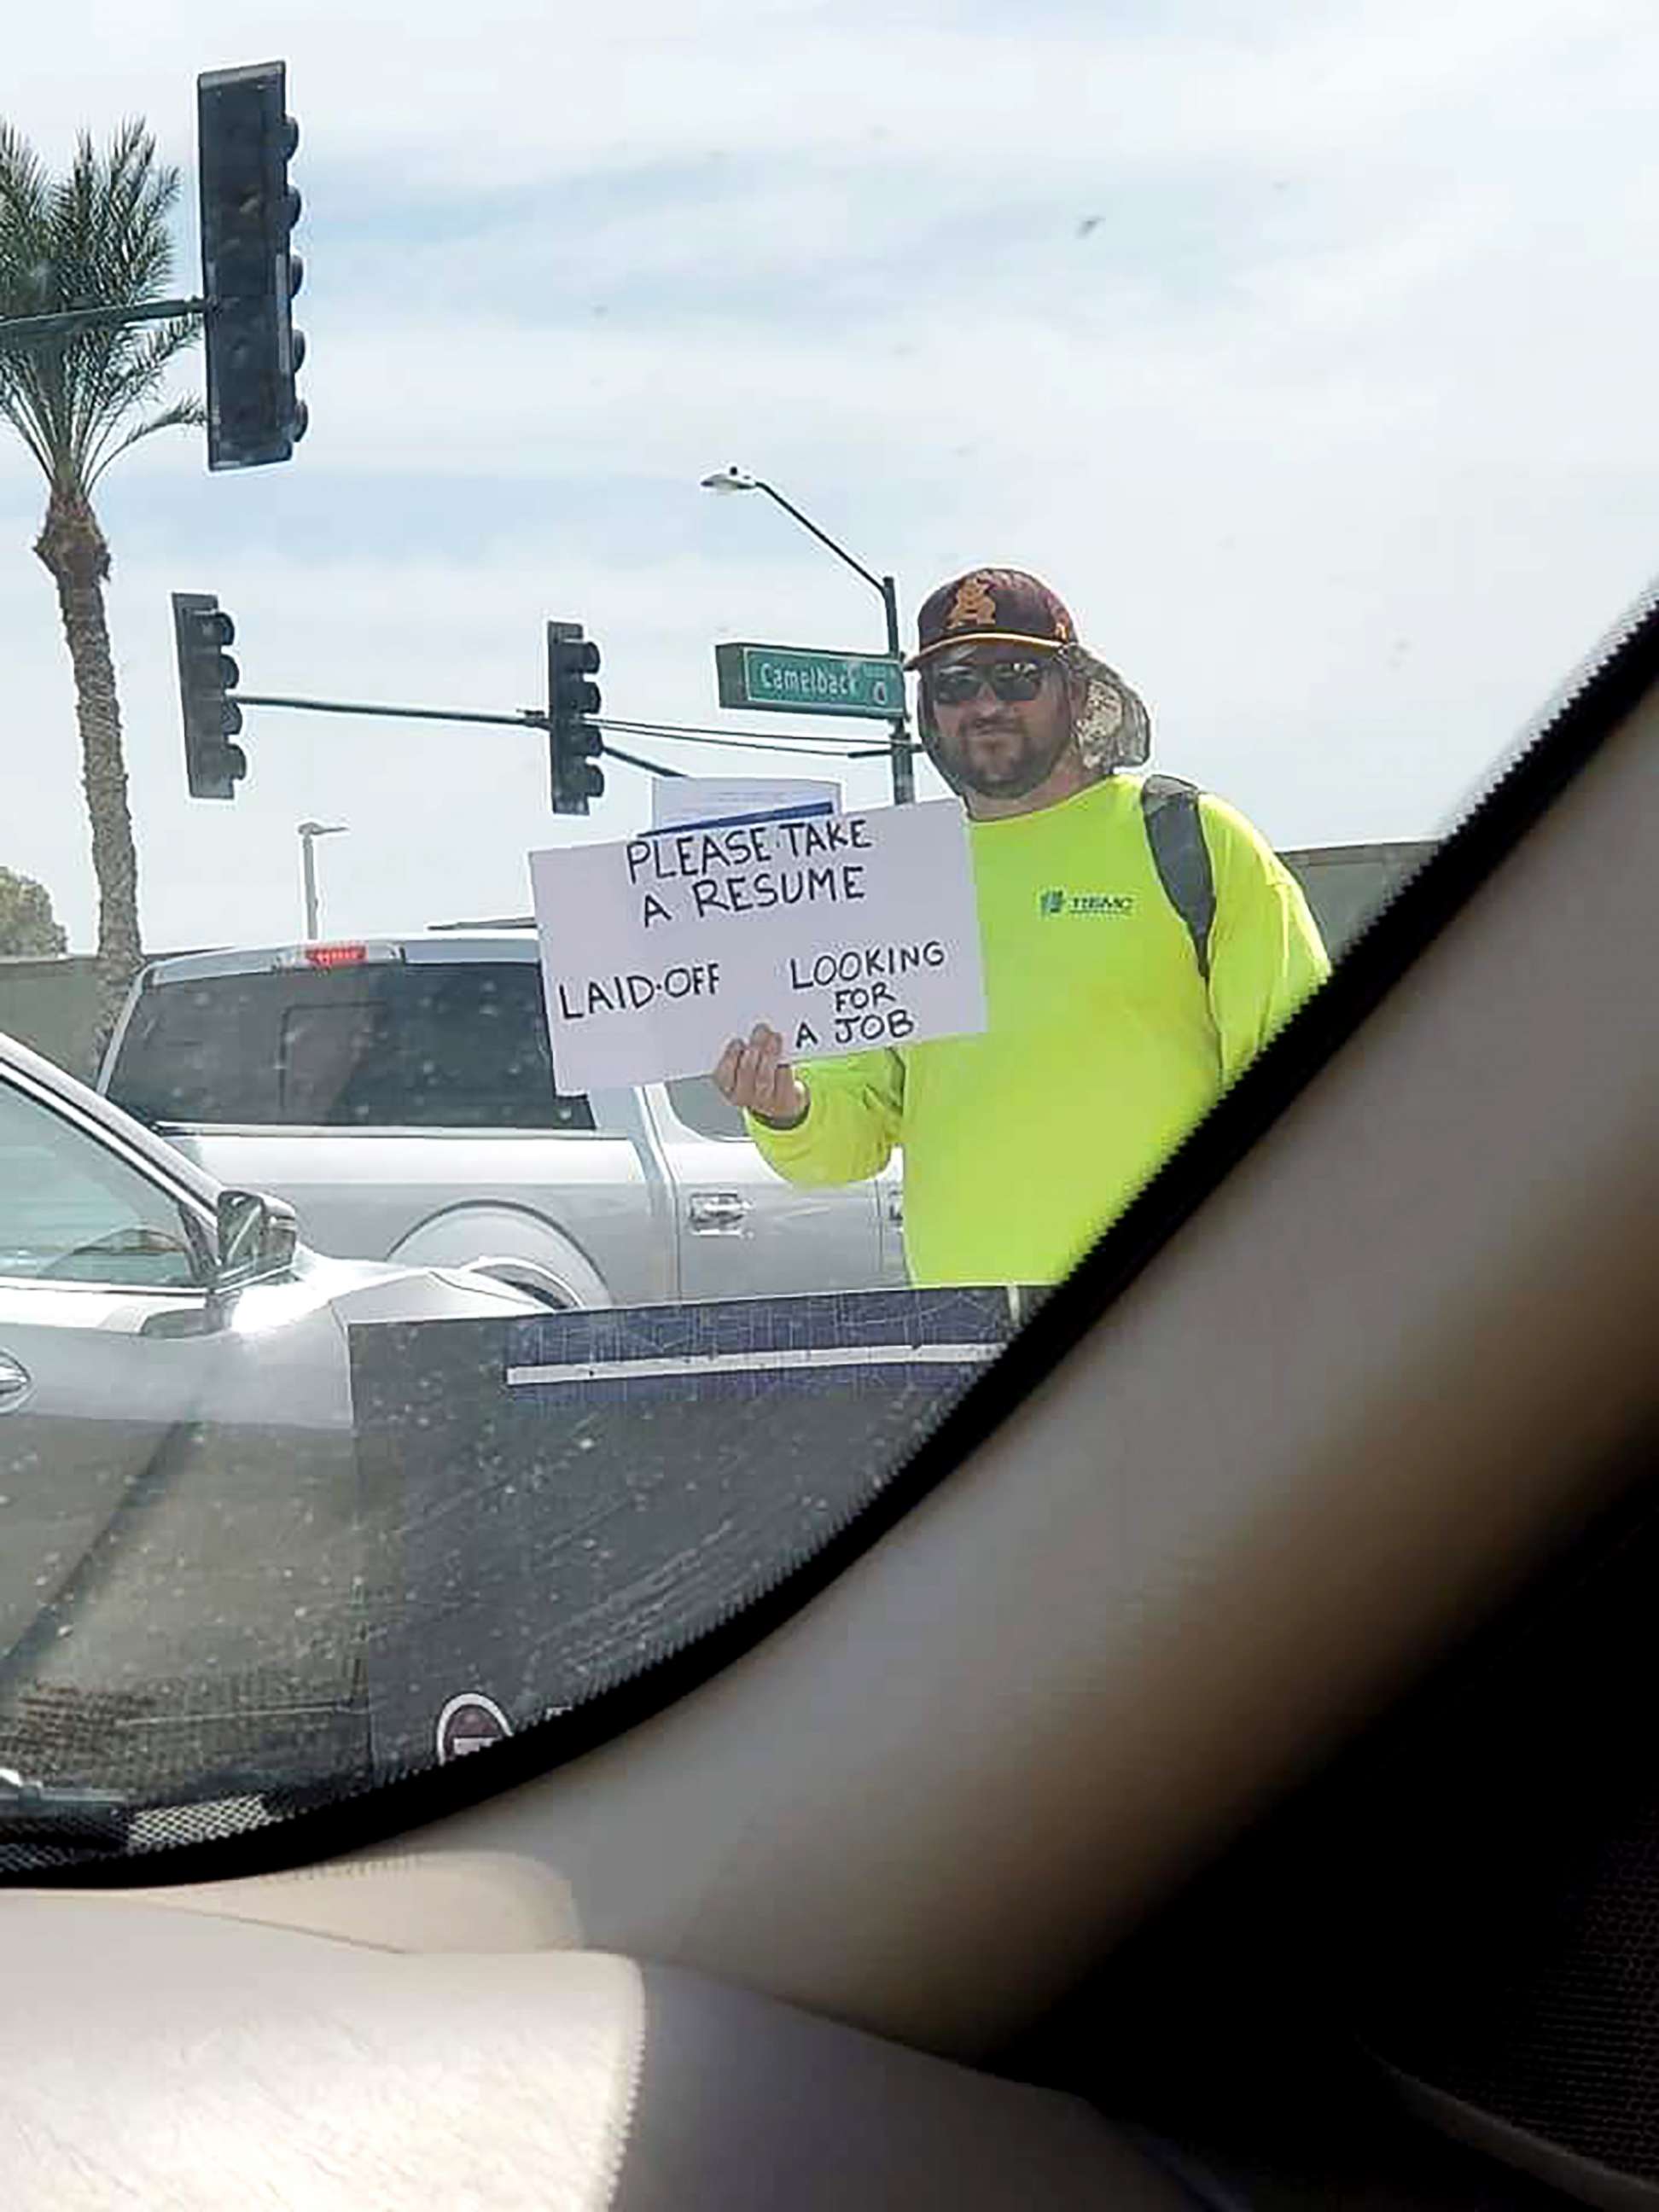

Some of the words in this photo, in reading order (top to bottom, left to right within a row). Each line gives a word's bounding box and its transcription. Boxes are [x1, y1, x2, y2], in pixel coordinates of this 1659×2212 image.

[760, 662, 857, 695] Camelback
[626, 826, 771, 884] PLEASE
[777, 819, 872, 858] TAKE
[644, 894, 672, 928] A
[691, 865, 865, 918] RESUME
[790, 940, 945, 990] LOOKING
[835, 981, 897, 1013] FOR
[795, 1022, 818, 1049] A
[835, 1009, 914, 1044] JOB
